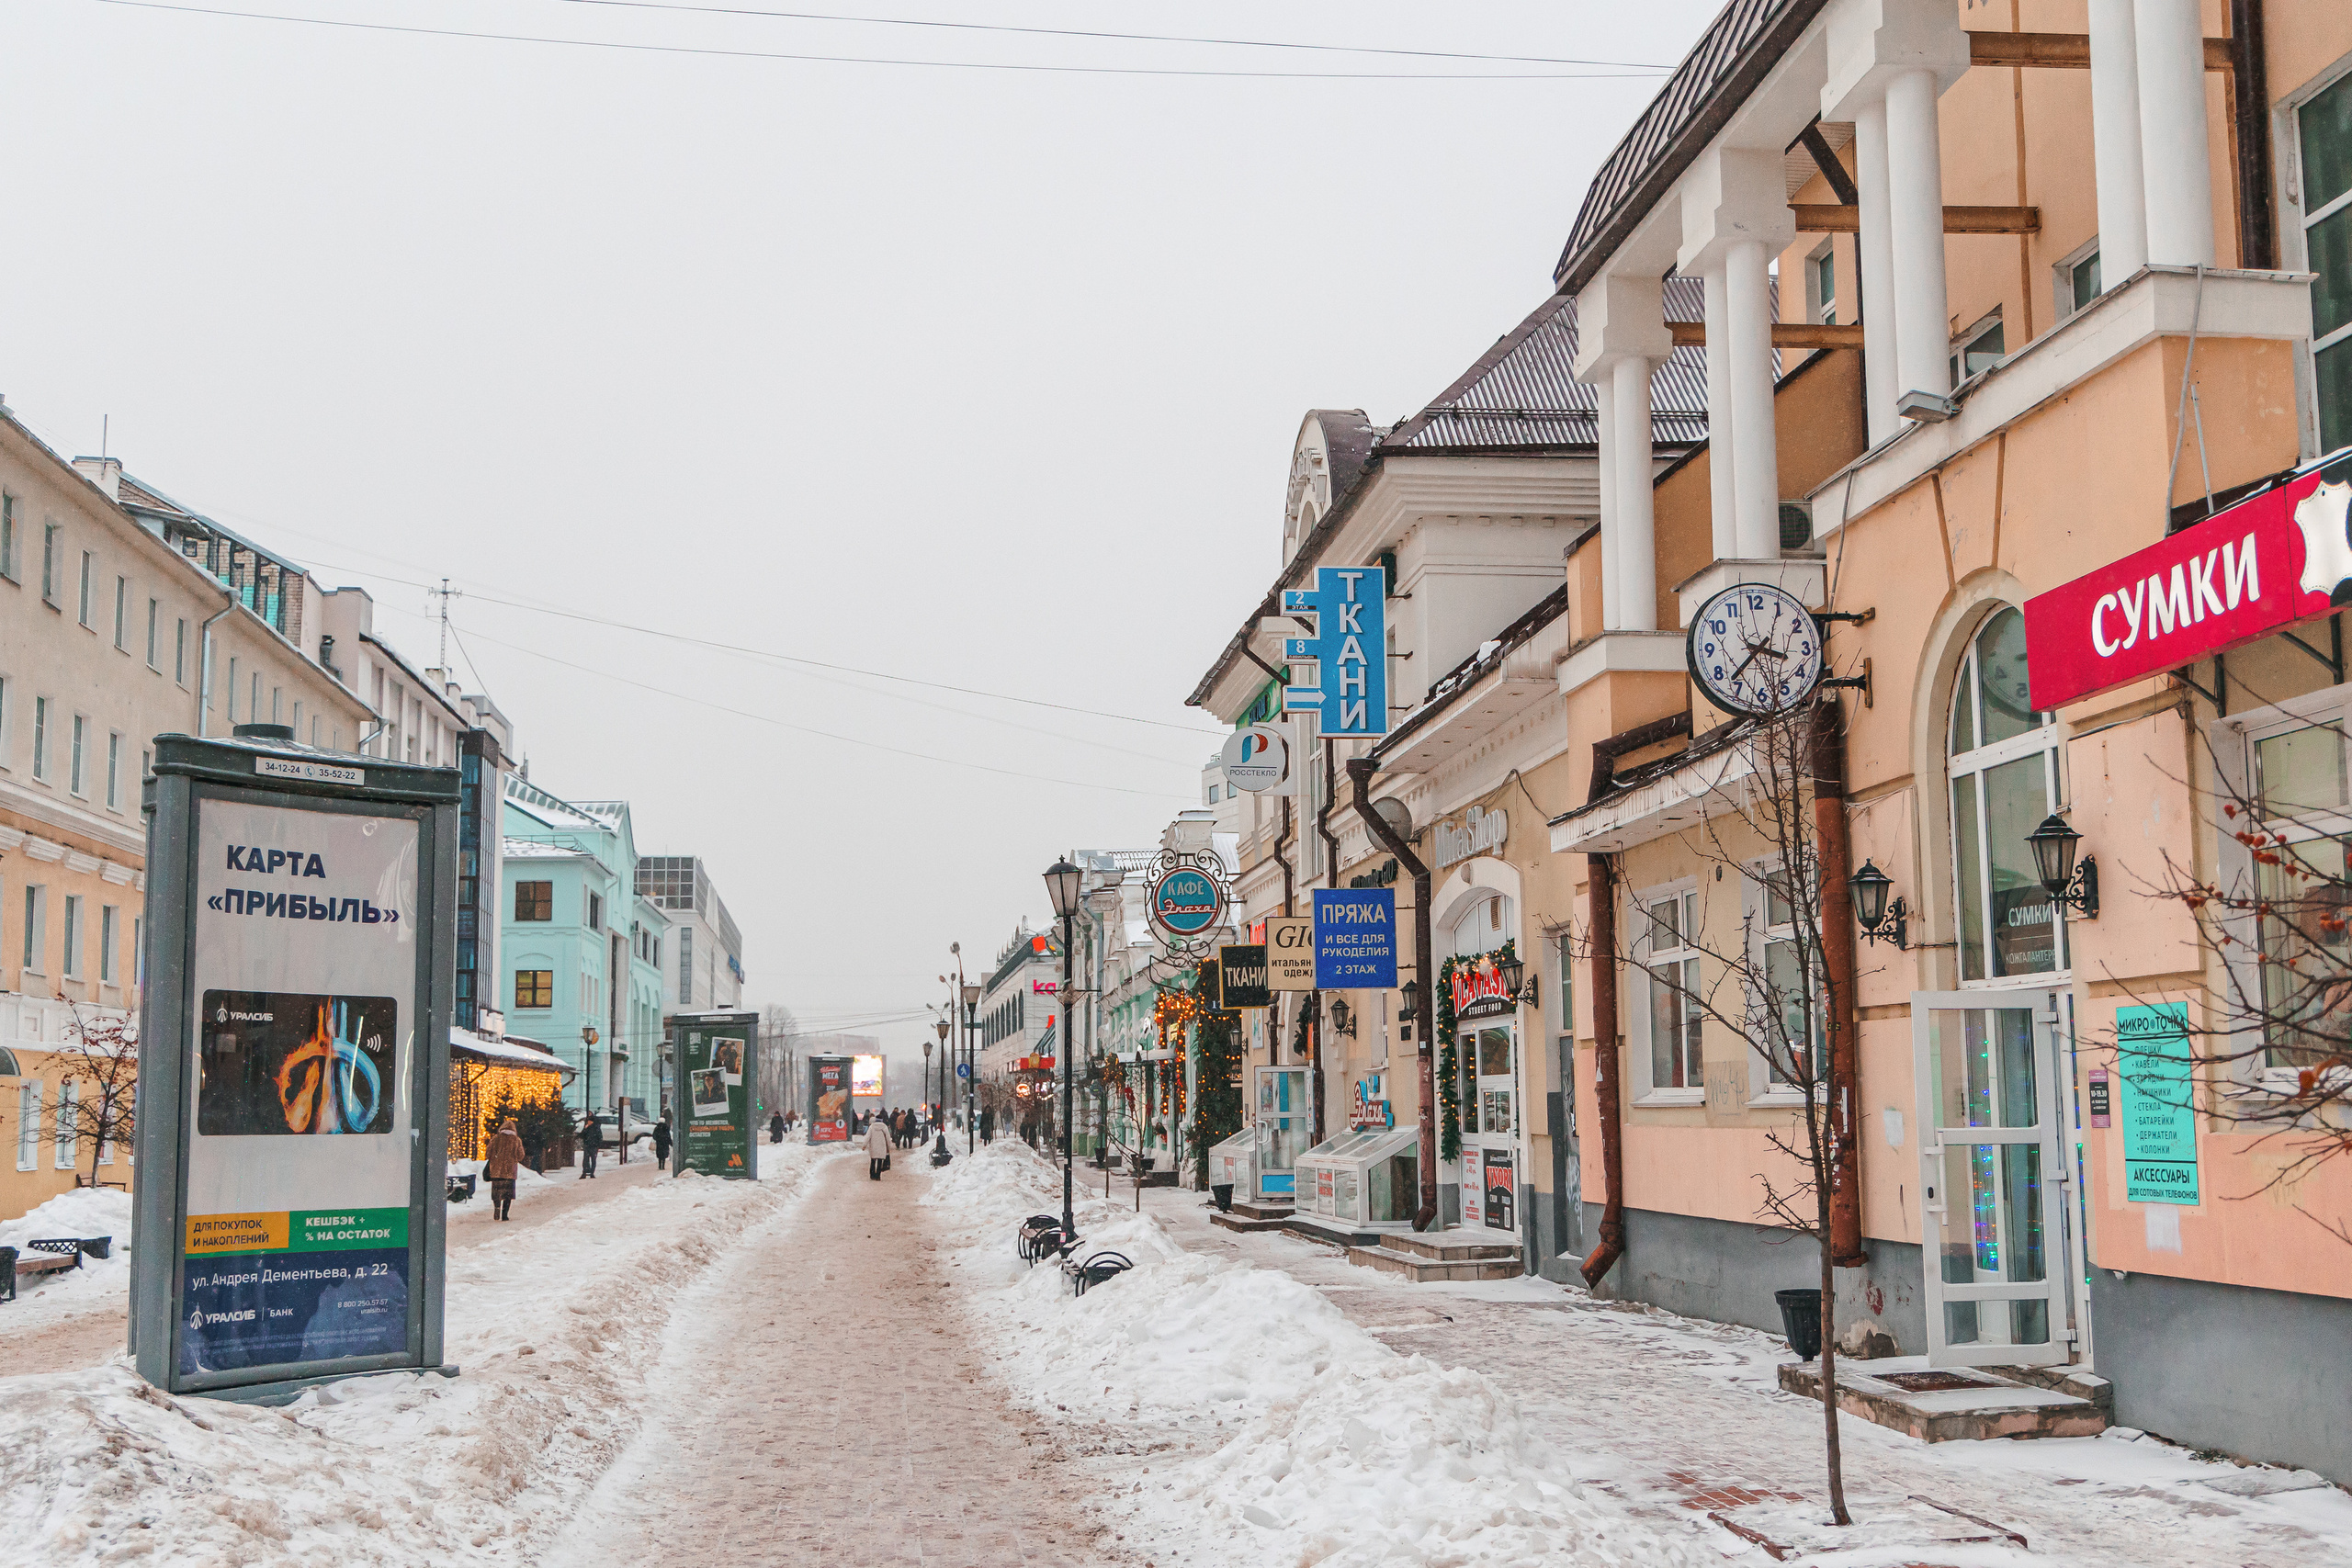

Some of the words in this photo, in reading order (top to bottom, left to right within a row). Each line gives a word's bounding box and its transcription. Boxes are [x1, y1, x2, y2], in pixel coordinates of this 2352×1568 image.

[1295, 592, 1305, 604] 2
[1747, 594, 1764, 610] 12
[2092, 532, 2260, 658] СУМКИ
[1725, 604, 1737, 617] 11
[1774, 602, 1781, 616] 1
[1709, 620, 1726, 635] 10
[1792, 618, 1802, 633] 2
[1295, 640, 1306, 653] 8
[1337, 572, 1367, 729] ТКАНИ
[1704, 642, 1714, 658] 9
[1801, 640, 1811, 656] 3
[1713, 666, 1724, 681] 8
[1795, 664, 1805, 679] 4
[1734, 682, 1743, 697] 7
[1757, 688, 1767, 703] 6
[1781, 681, 1790, 695] 5
[265, 761, 300, 774] 34-12-24
[319, 768, 356, 780] 35-52-22
[1229, 769, 1277, 777] РОССТЕКЛО
[226, 844, 326, 878] КАРТА
[1167, 880, 1204, 896] КАФЕ
[207, 888, 401, 924] «ПРИБЫЛЬ»
[1158, 898, 1216, 916] Эпоха
[1322, 904, 1386, 924] ПРЯЖА
[2008, 904, 2052, 927] СУМКИ
[1325, 935, 1333, 943] И
[1336, 934, 1358, 943] ВСЕ
[1362, 934, 1385, 945] ДЛЯ
[1322, 947, 1389, 958] РУКОДЕЛИЯ
[1225, 965, 1266, 987] ТКАНИ
[1336, 965, 1342, 974] 2
[1345, 964, 1376, 974] ЭТАЖ
[230, 1011, 274, 1021] УРАЛСИБ
[1468, 1004, 1487, 1015] STREET
[1488, 1002, 1502, 1011] FOOD
[2119, 1017, 2149, 1032] МИКРО
[2138, 1102, 2161, 1111] СТЕКЛА
[2139, 1114, 2174, 1125] БАТАРЕЙКИ
[2140, 1131, 2177, 1141] ДЕРЖАТЕЛИ
[2141, 1145, 2170, 1154] КОЛОНКИ
[2133, 1168, 2190, 1184] АКСЕССУАРЫ
[2129, 1188, 2139, 1198] ДЛЯ
[2140, 1189, 2165, 1198] СОТОВЫХ
[2165, 1190, 2198, 1200] ТЕЛЕФОНОВ
[193, 1222, 211, 1234] ДЛЯ
[214, 1219, 263, 1231] ПОКУПОК
[306, 1216, 356, 1226] КЕШБЭК
[193, 1238, 200, 1247] И
[202, 1232, 269, 1247] НАКОПЛЕНИЙ
[305, 1232, 313, 1241] %
[317, 1231, 334, 1240] НА
[337, 1228, 390, 1240] ОСТАТОК
[193, 1277, 209, 1291] ул.
[211, 1273, 258, 1287] Андрея
[262, 1267, 351, 1284] Дементьева,
[356, 1267, 368, 1279] д.
[371, 1263, 389, 1276] 22
[206, 1310, 255, 1324] УРАЛСИБ
[269, 1307, 294, 1317] БАНК
